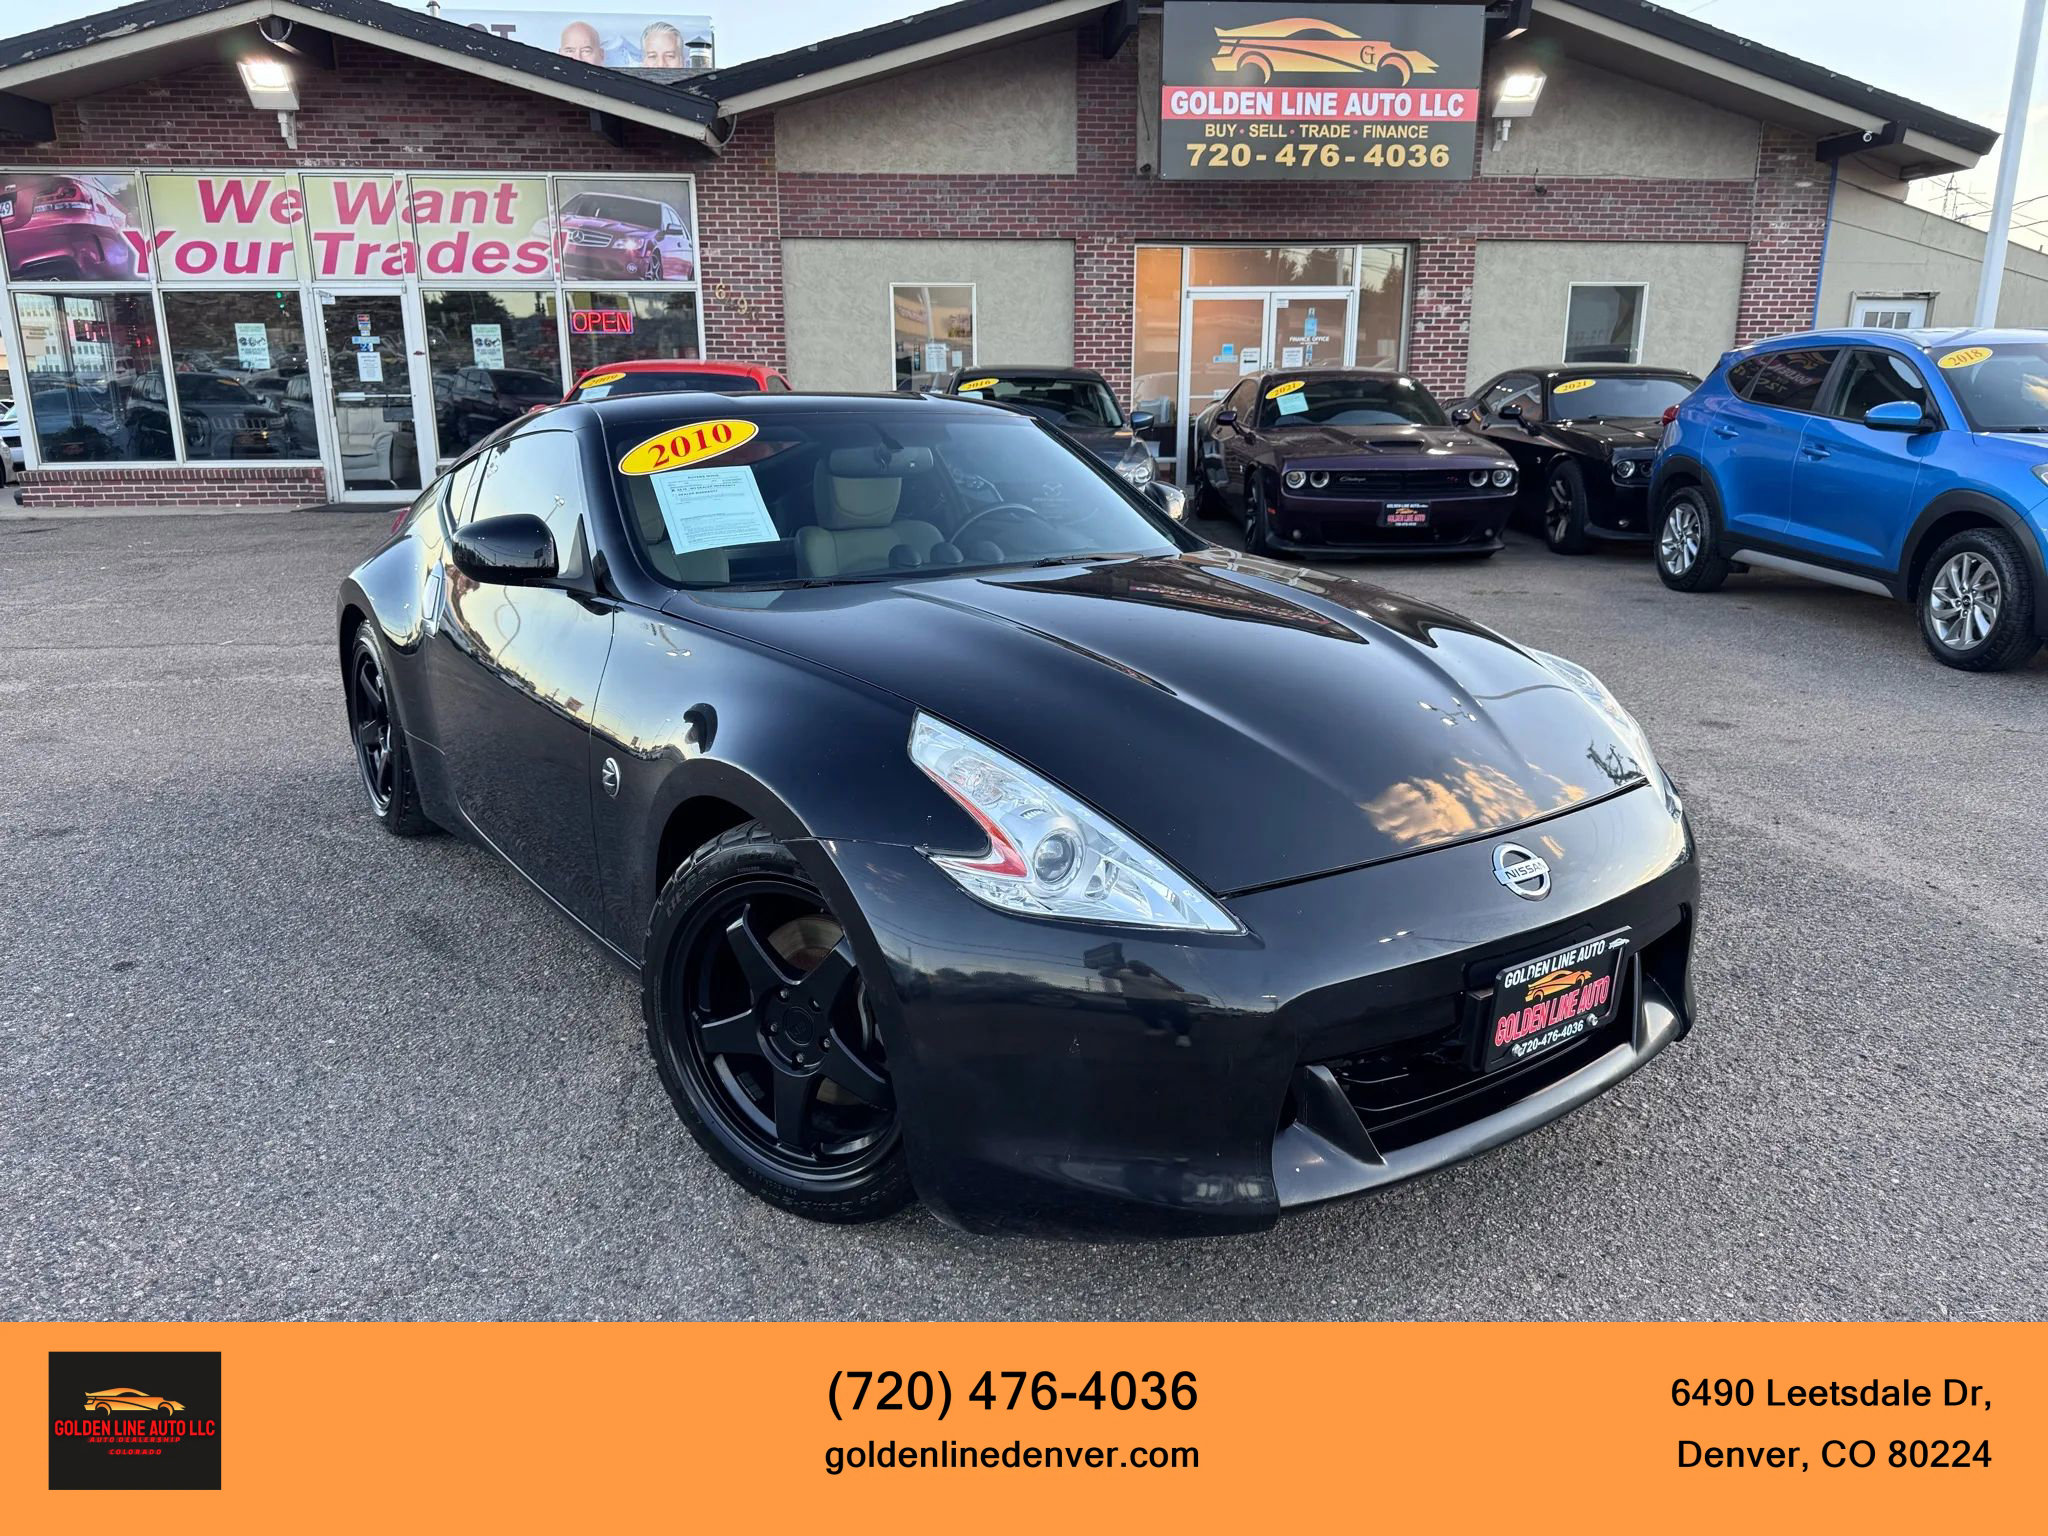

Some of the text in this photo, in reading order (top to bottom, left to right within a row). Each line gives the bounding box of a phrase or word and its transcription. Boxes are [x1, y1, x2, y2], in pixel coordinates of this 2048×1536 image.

[1170, 91, 1465, 117] GOLDEN LINE AUTO LLC
[1205, 124, 1428, 139] BUY SELL TRADE FINANCE
[198, 180, 519, 225] We Want
[122, 230, 568, 275] Your Trades!
[573, 311, 631, 333] OPEN
[1948, 349, 1983, 366] 2018
[648, 423, 732, 468] 2010
[1505, 861, 1547, 880] NISSAN
[1504, 939, 1606, 989] GOLDEN LINE AUTO
[1495, 975, 1611, 1047] GOLDEN LINE AUTO
[1521, 1019, 1584, 1055] 720-476-4036
